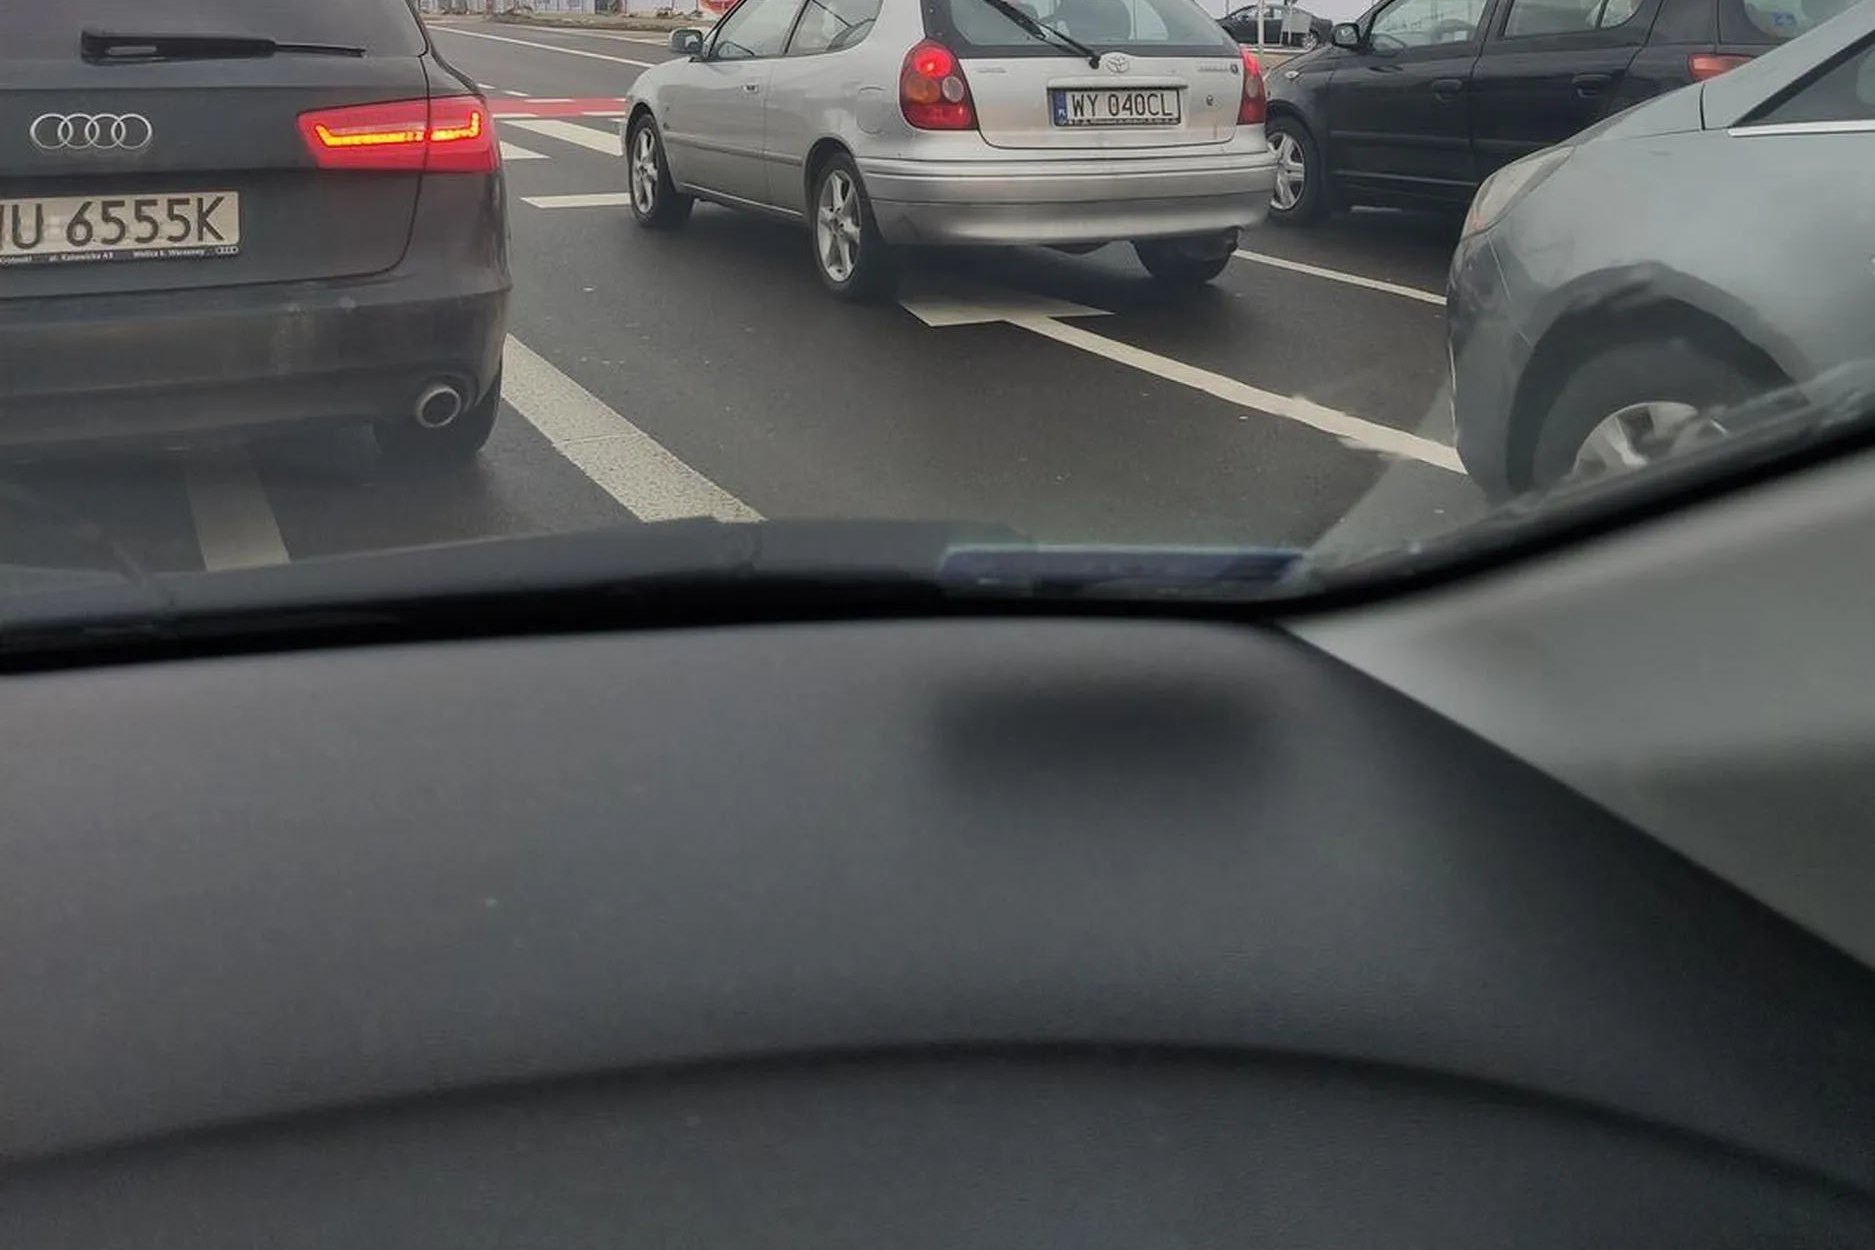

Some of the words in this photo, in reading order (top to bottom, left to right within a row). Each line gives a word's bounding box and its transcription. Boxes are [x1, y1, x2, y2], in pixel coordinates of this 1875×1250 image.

[1071, 93, 1098, 117] WY
[1108, 92, 1173, 117] 040CL
[0, 203, 43, 249] U
[66, 196, 225, 247] 6555K
